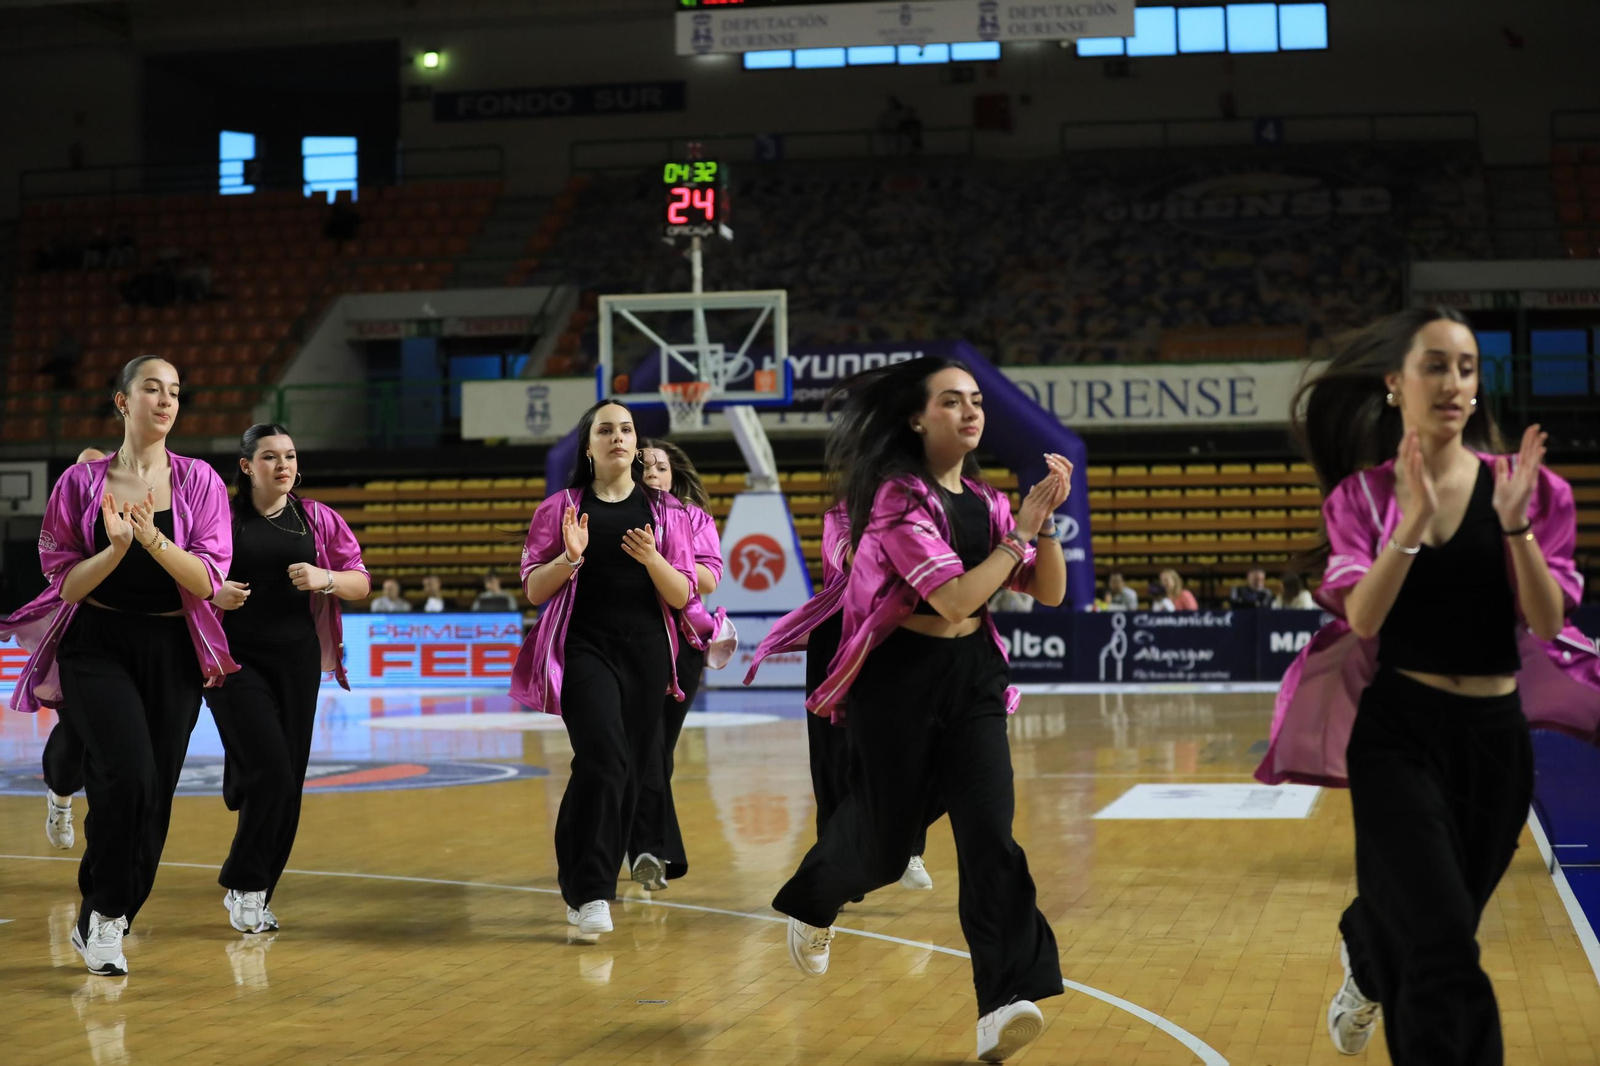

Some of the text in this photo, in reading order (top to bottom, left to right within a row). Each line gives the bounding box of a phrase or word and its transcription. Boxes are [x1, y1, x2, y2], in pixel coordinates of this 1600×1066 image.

[1009, 2, 1117, 19] DEPUTACIÓN
[721, 14, 828, 32] DEPUTACIÓN
[1009, 20, 1086, 35] OURENSE
[722, 33, 797, 48] OURENSE
[457, 86, 664, 116] FONDO SUR
[1260, 120, 1278, 142] 4
[667, 187, 715, 224] 24
[369, 624, 523, 638] PRIMERA
[1269, 631, 1314, 653] MA
[370, 643, 522, 677] FEB
